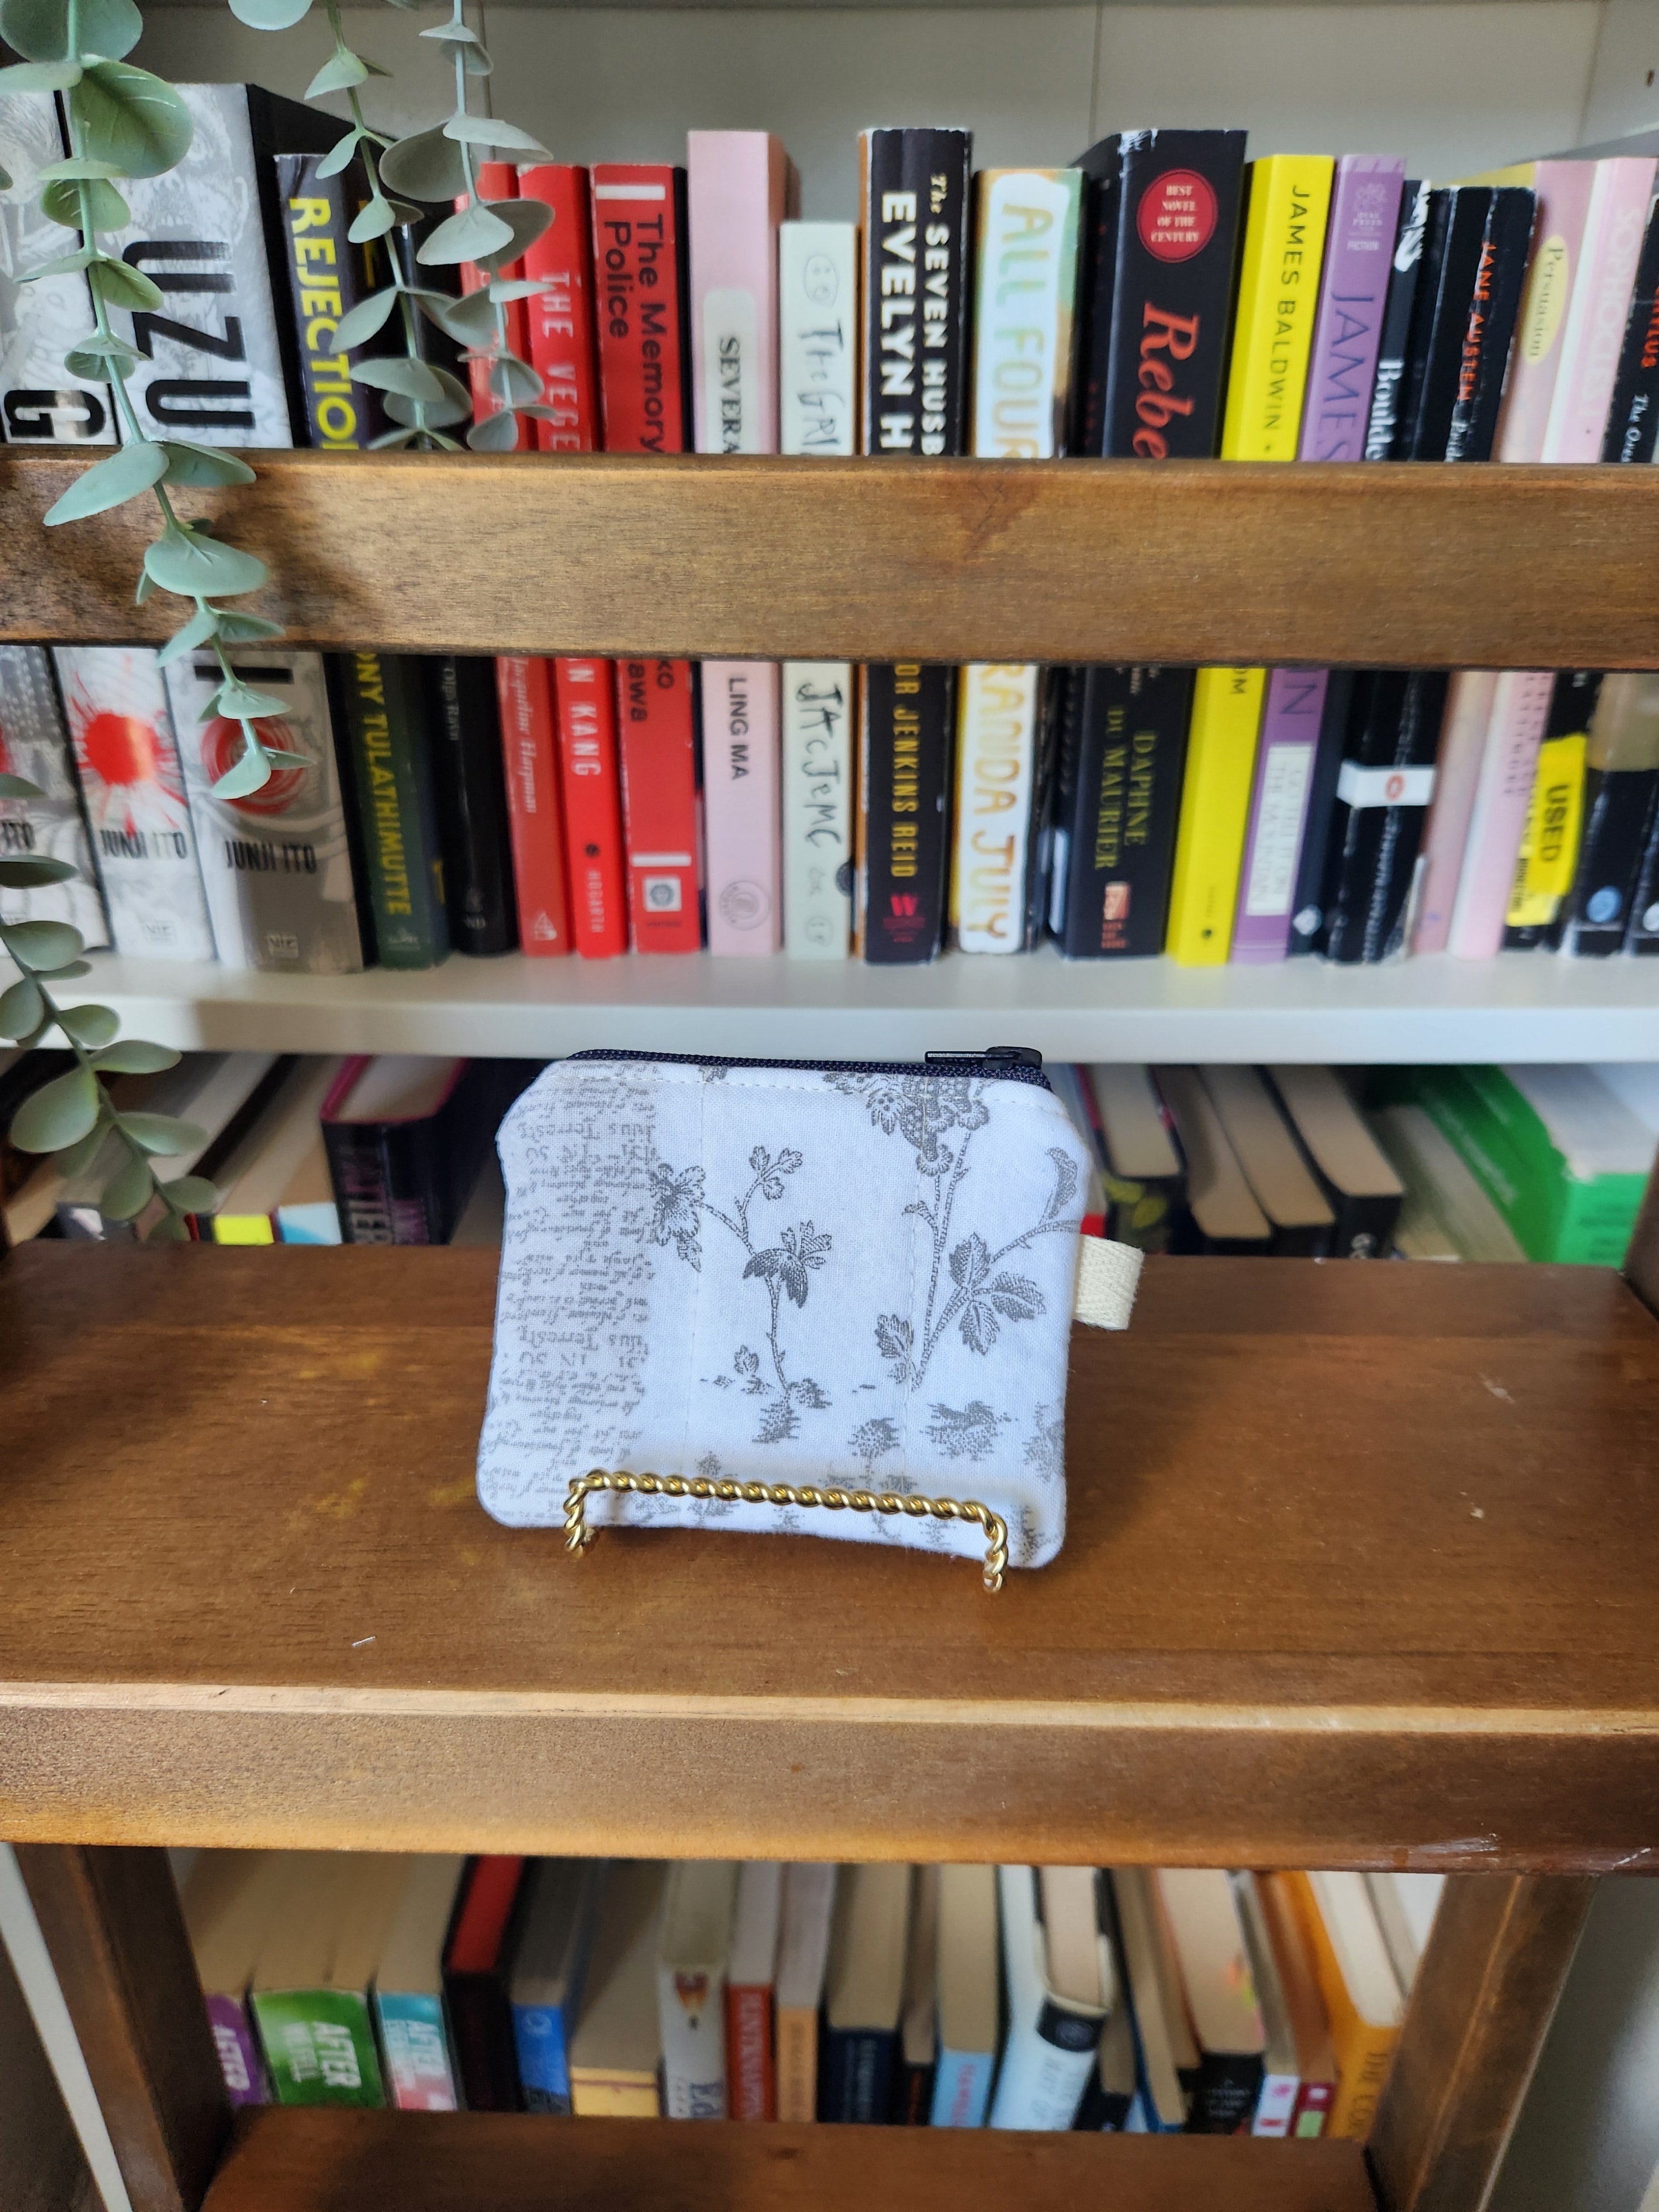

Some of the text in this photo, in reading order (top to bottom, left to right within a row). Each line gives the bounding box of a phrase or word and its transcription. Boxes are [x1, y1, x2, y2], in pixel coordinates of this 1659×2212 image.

[1151, 231, 1199, 243] CENTURY
[1157, 216, 1196, 227] OF THE
[1162, 200, 1196, 212] NOVEL
[1166, 185, 1193, 196] BEST
[541, 272, 573, 338] THE
[604, 221, 632, 339] Police
[922, 224, 950, 348] SEVEN
[998, 203, 1053, 308] ALL
[1262, 185, 1311, 430] JAMES BALDWIN
[1530, 247, 1565, 357] Persuasion
[637, 213, 667, 453] The Memory
[879, 191, 916, 448] EVELYN H
[1457, 241, 1498, 401] JANE AUSTEN
[797, 390, 845, 457] GRI
[1133, 300, 1201, 459] Rebe
[1319, 290, 1375, 461] JAMES
[563, 658, 602, 776] N KANG
[728, 676, 750, 781] LING MA
[891, 706, 921, 813] JENKINS
[1124, 729, 1159, 847] DAPHNE
[1539, 783, 1570, 863] USED
[100, 830, 188, 860] JUNJI ITO
[226, 840, 317, 874] JUNJI ITO
[889, 821, 919, 878] REID
[967, 828, 1015, 939] JULY
[587, 869, 605, 934] HOGARTH
